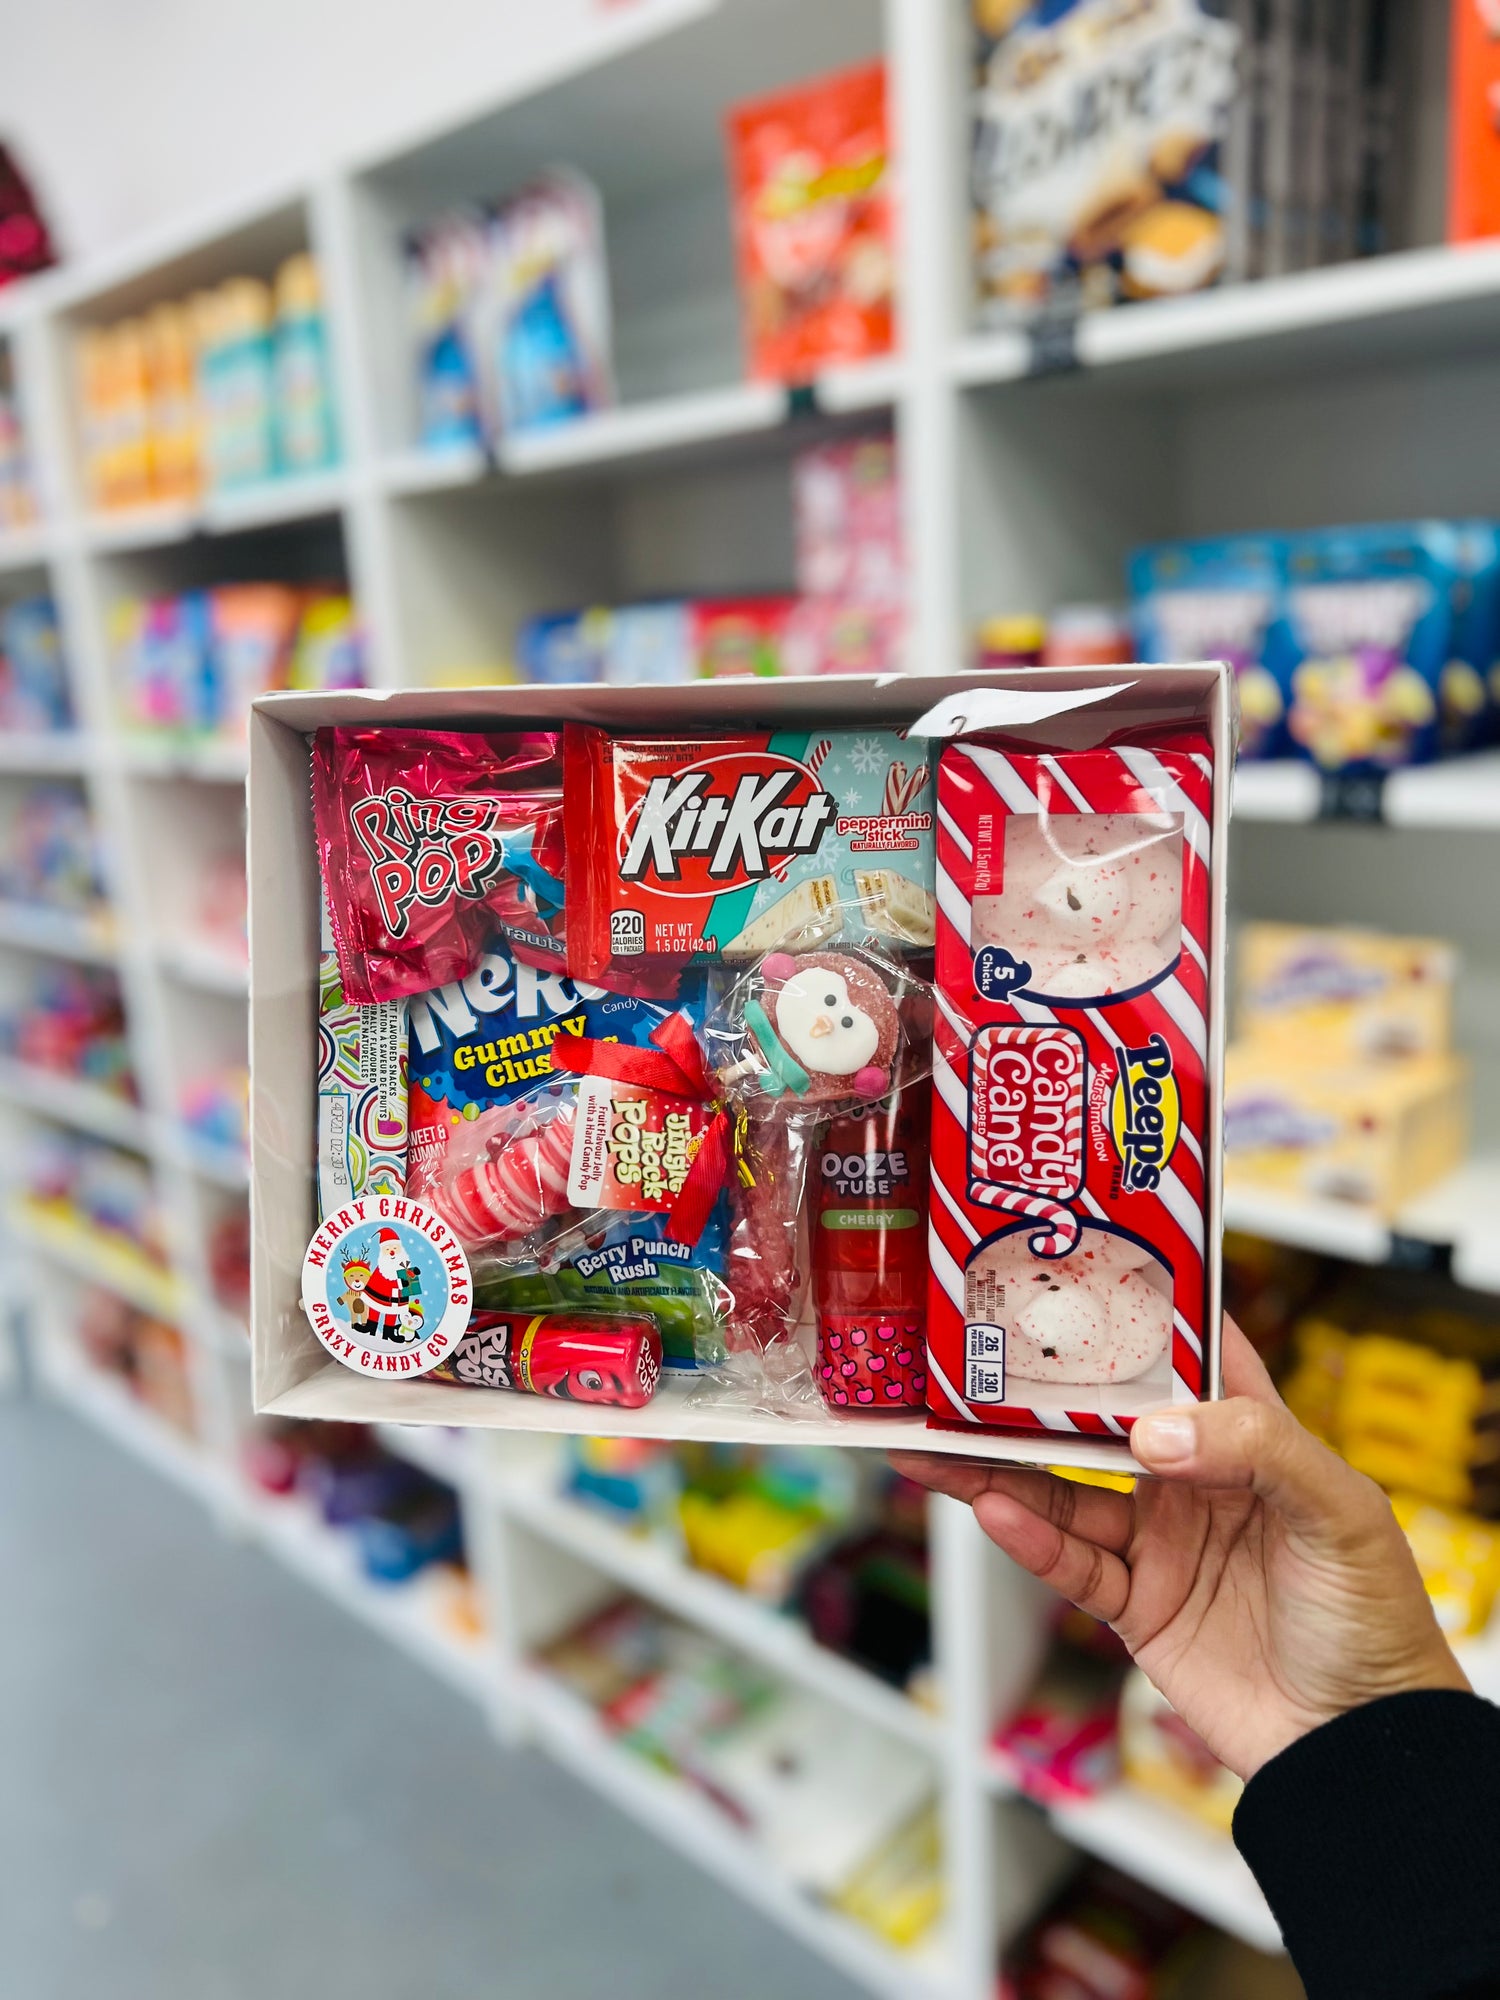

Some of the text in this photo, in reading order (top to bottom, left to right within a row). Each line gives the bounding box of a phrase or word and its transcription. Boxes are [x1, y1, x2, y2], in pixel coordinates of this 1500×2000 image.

[351, 786, 501, 864] Ring
[838, 813, 932, 832] peppermint
[977, 814, 993, 828] NET
[852, 840, 917, 850] NATURALLY FLAVORED
[867, 829, 902, 841] stick
[977, 829, 992, 846] WT.
[977, 847, 991, 860] 1.5
[974, 870, 990, 891] (42g)
[612, 916, 642, 934] 220
[655, 923, 693, 937] NET WT
[613, 936, 643, 945] CALORIES
[656, 939, 671, 952] 1.5
[674, 939, 686, 952] OZ
[689, 938, 704, 953] (42
[982, 953, 994, 991] Chicks
[994, 966, 1015, 981] 5
[602, 998, 639, 1014] Candy
[389, 1015, 397, 1061] FLAVOURED
[454, 1015, 587, 1071] Gummy
[380, 1044, 388, 1074] SAVEUR
[380, 1077, 387, 1087] DE
[389, 1064, 397, 1097] SNACKS
[379, 1090, 387, 1118] FRUITS
[587, 1095, 597, 1114] with
[976, 1079, 988, 1136] FLAVORED
[987, 1050, 1032, 1167] Cane
[1019, 1039, 1076, 1187] Candy
[1090, 1062, 1114, 1162] Marshmallow
[1122, 1033, 1173, 1190] Peeps
[437, 1124, 447, 1140] &
[584, 1124, 595, 1145] Hard
[591, 1106, 608, 1181] Fruit Flavour Jelly
[606, 1099, 648, 1185] Pops
[409, 1141, 446, 1164] GUMMY
[580, 1146, 593, 1173] Candy
[641, 1130, 669, 1199] Rock
[821, 1152, 908, 1178] OOZE
[578, 1174, 590, 1191] Pop
[836, 1179, 890, 1195] TUBE
[1110, 1165, 1122, 1200] BRAND
[839, 1214, 895, 1225] CHERRY
[307, 1198, 468, 1306] MERRY CHRISTMAS
[577, 1238, 690, 1276] Berry Punch
[608, 1258, 657, 1283] Rush
[312, 1303, 448, 1372] CRAZY CANDY CO
[984, 1336, 999, 1352] 26
[454, 1337, 489, 1387] PO
[478, 1325, 512, 1389] PUS
[641, 1336, 660, 1386] PUSH
[635, 1356, 653, 1394] POP
[984, 1371, 998, 1393] 130
